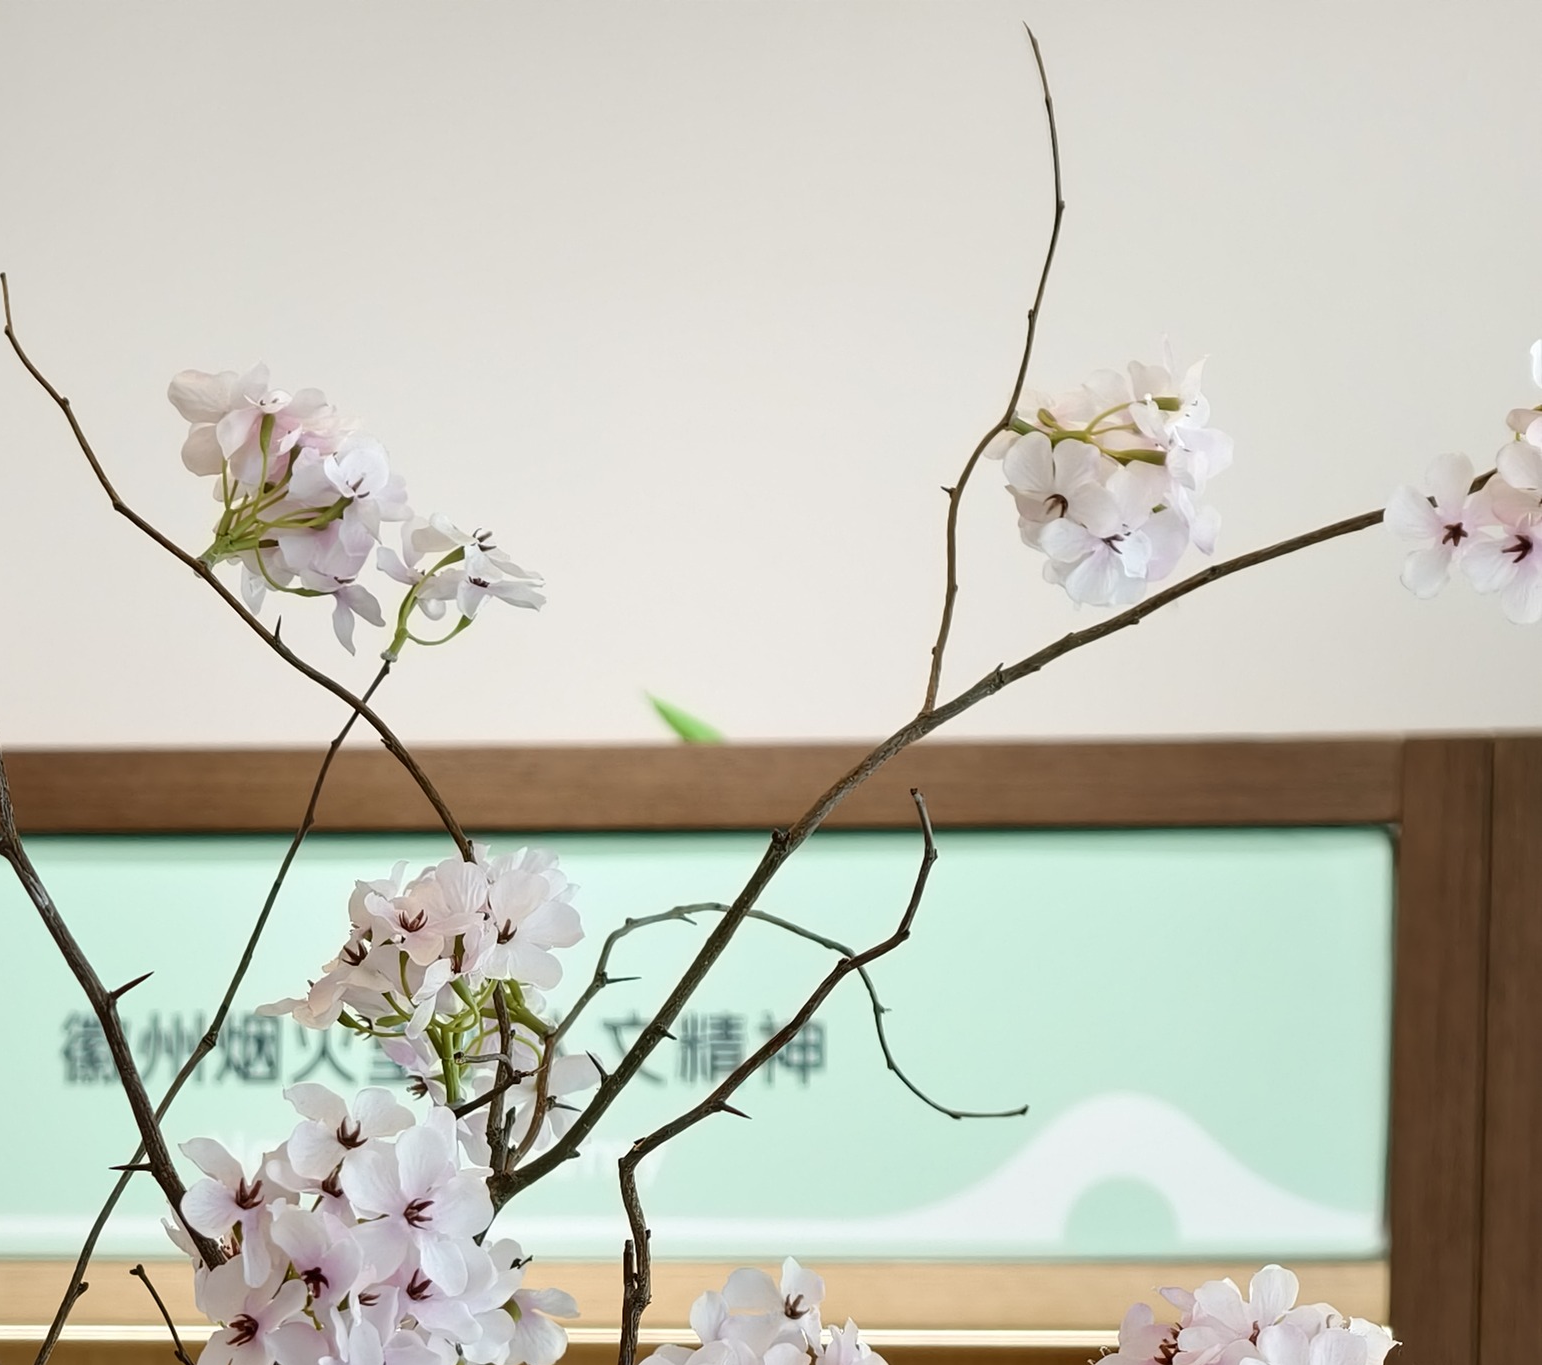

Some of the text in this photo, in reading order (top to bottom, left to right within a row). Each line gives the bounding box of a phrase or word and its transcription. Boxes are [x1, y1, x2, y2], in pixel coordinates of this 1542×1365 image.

[60, 1011, 828, 1088] 徽州烟火文精神
